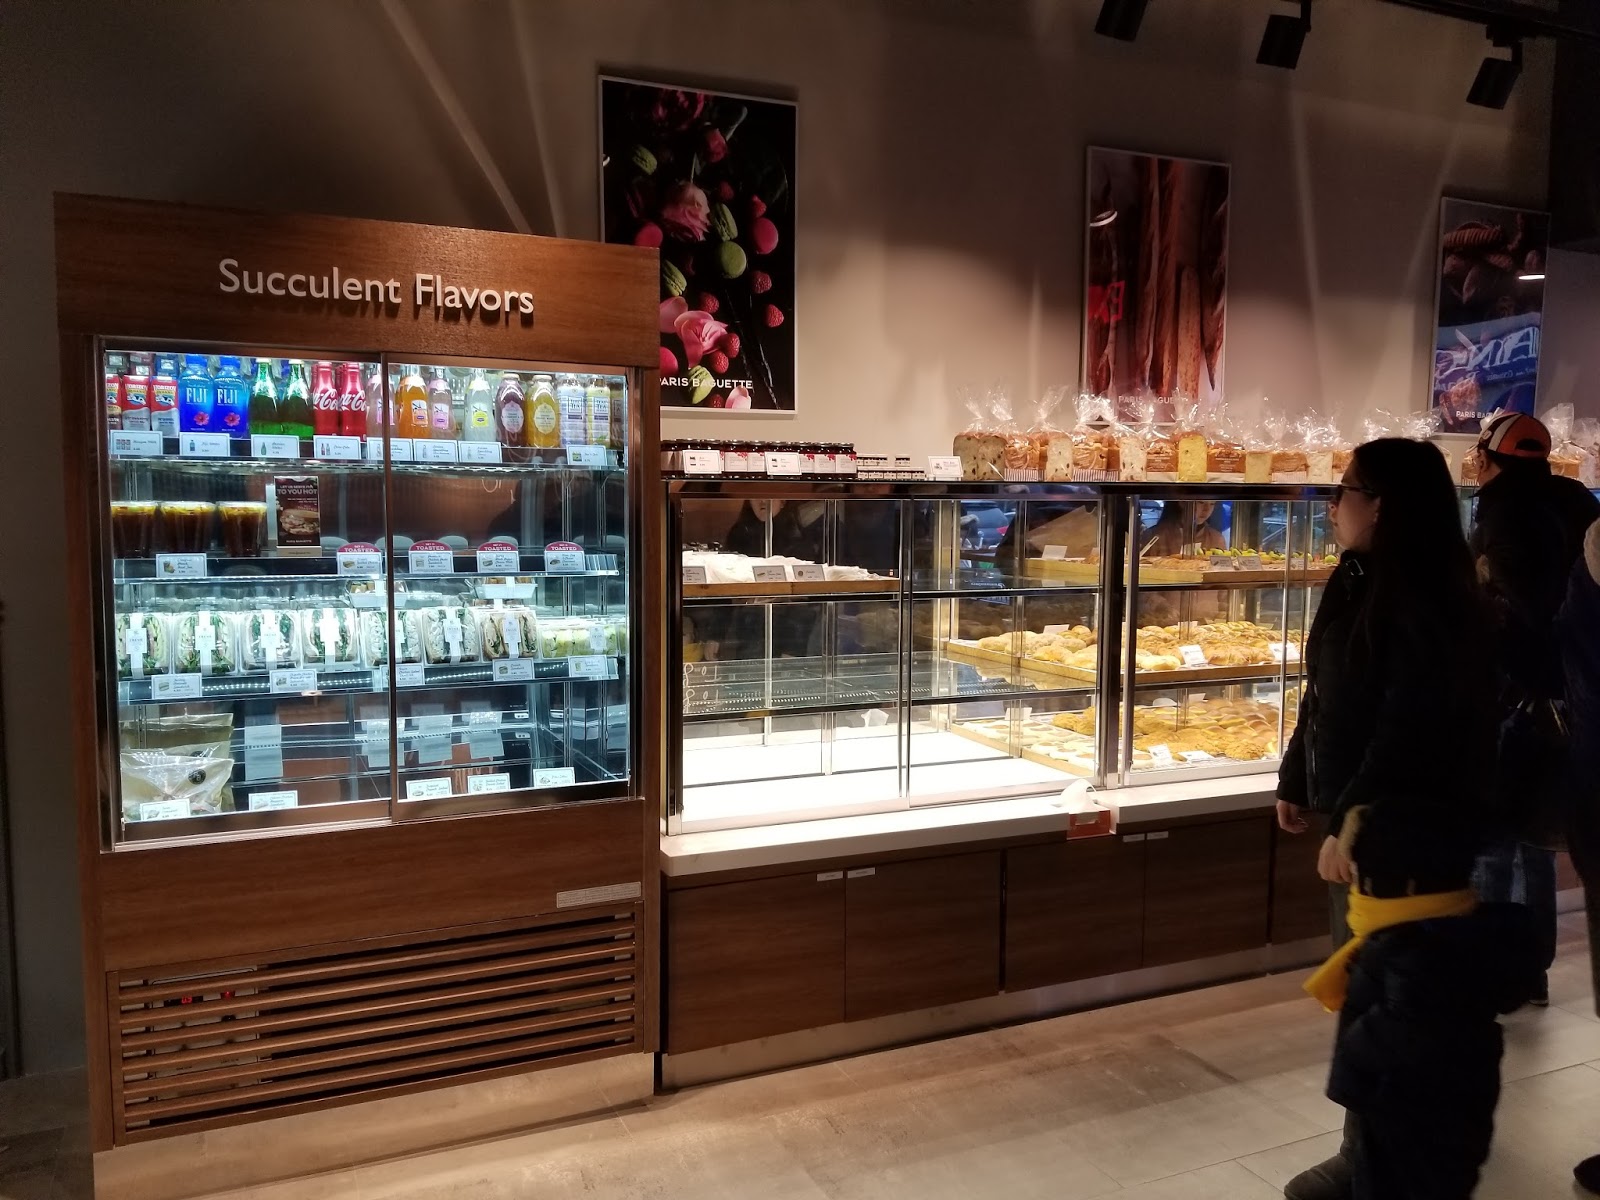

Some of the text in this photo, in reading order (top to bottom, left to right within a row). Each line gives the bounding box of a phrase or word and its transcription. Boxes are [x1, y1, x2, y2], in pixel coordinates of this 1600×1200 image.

[218, 258, 534, 314] Succulent Flavors
[660, 377, 753, 389] ARIS BAGUETTE
[186, 387, 208, 403] FIJI
[216, 388, 239, 404] FIJI
